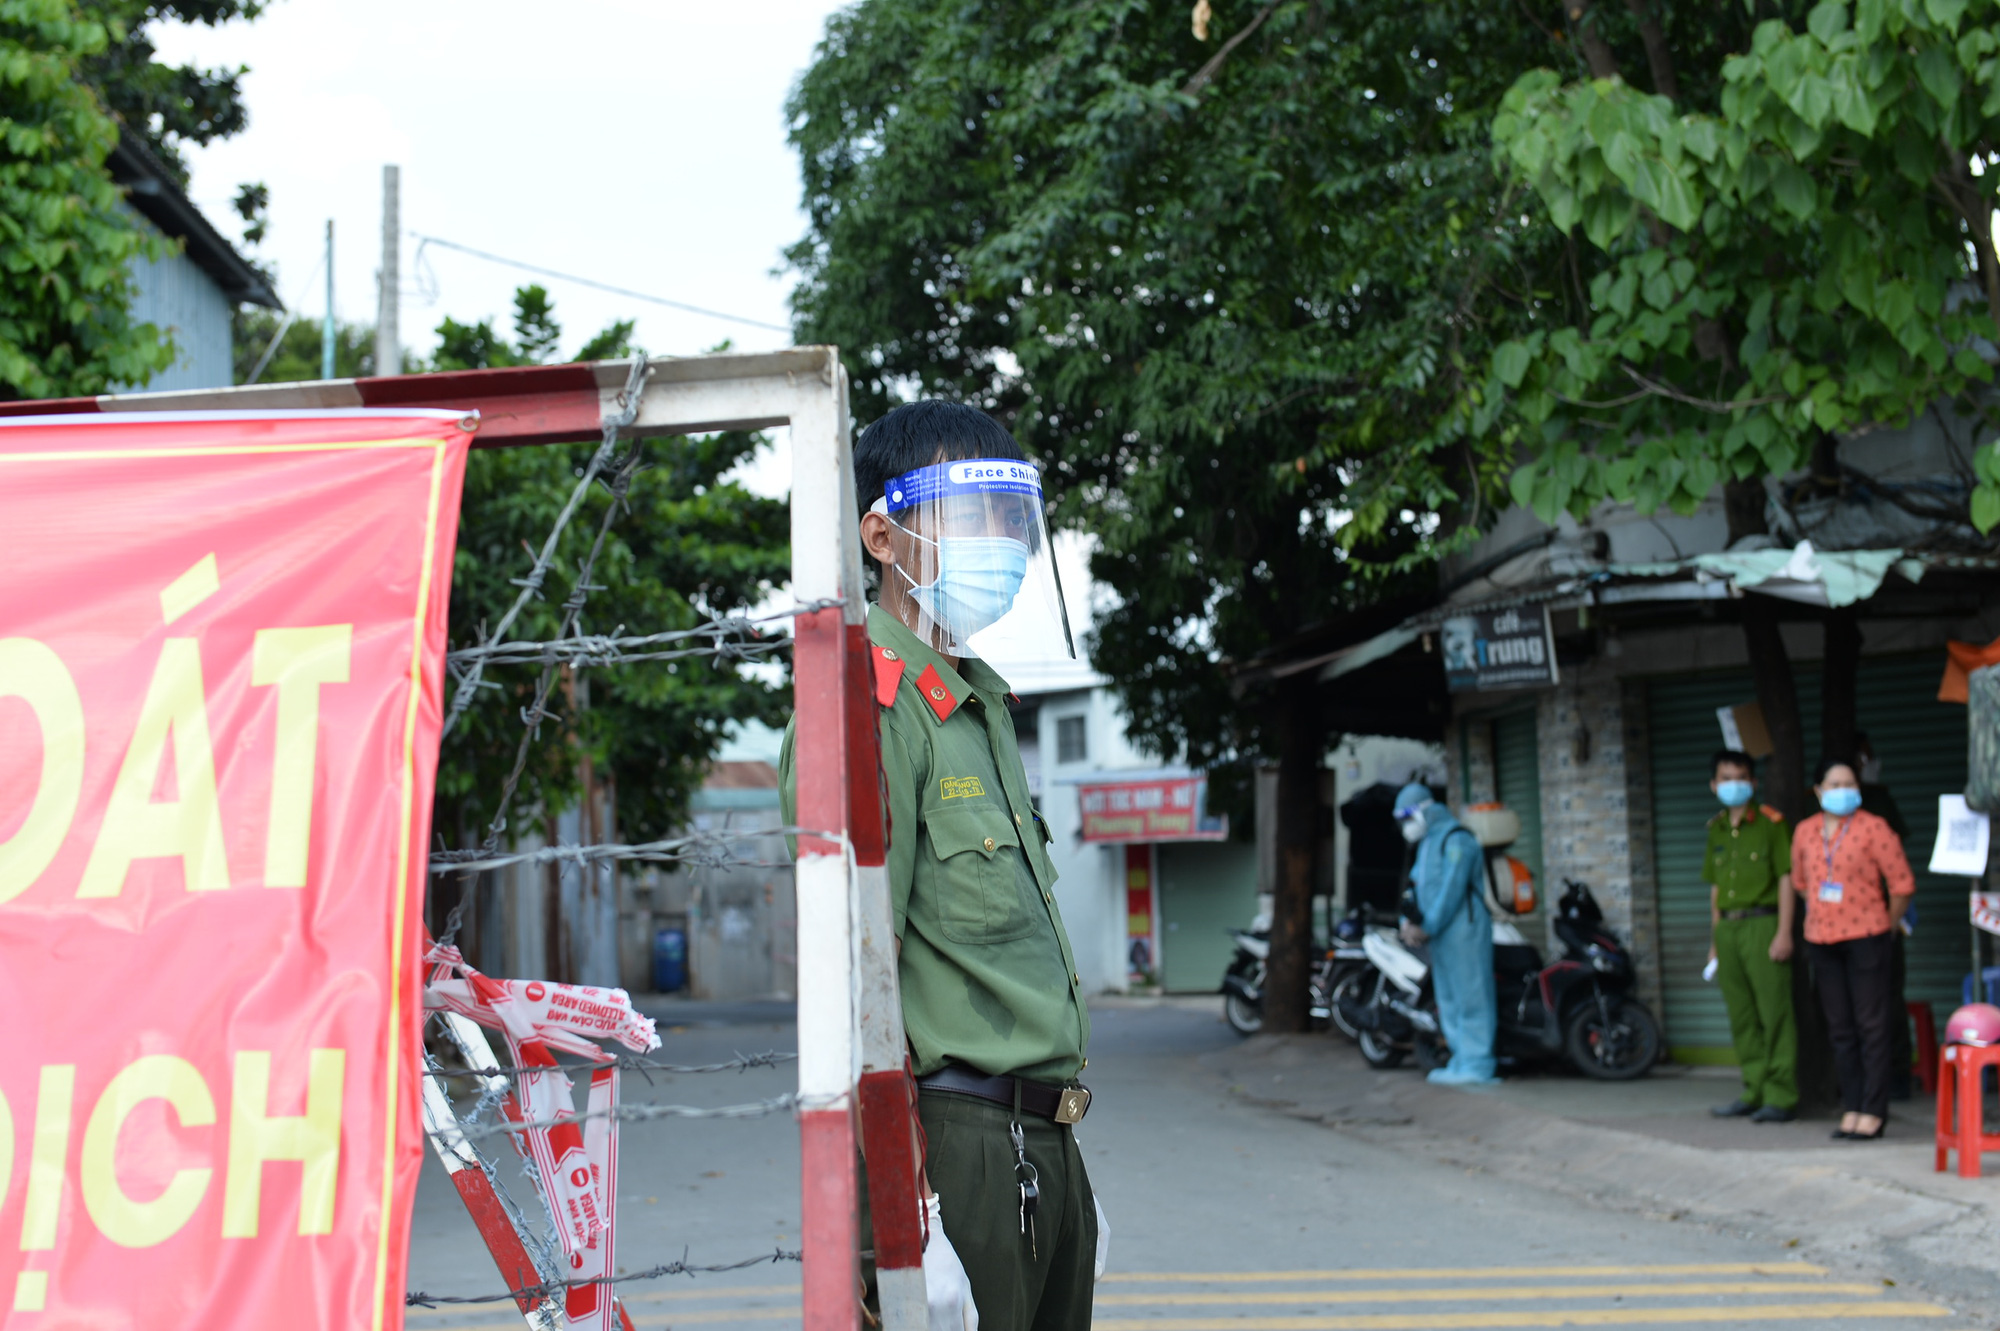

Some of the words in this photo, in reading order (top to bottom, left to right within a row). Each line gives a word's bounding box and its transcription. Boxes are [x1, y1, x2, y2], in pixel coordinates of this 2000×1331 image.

[963, 467, 1004, 479] Face
[1009, 484, 1029, 492] Isolation
[1475, 636, 1545, 666] Trung
[551, 993, 578, 1009] AREA
[579, 1000, 626, 1021] ALLOWED
[0, 1048, 346, 1312] ỊCH
